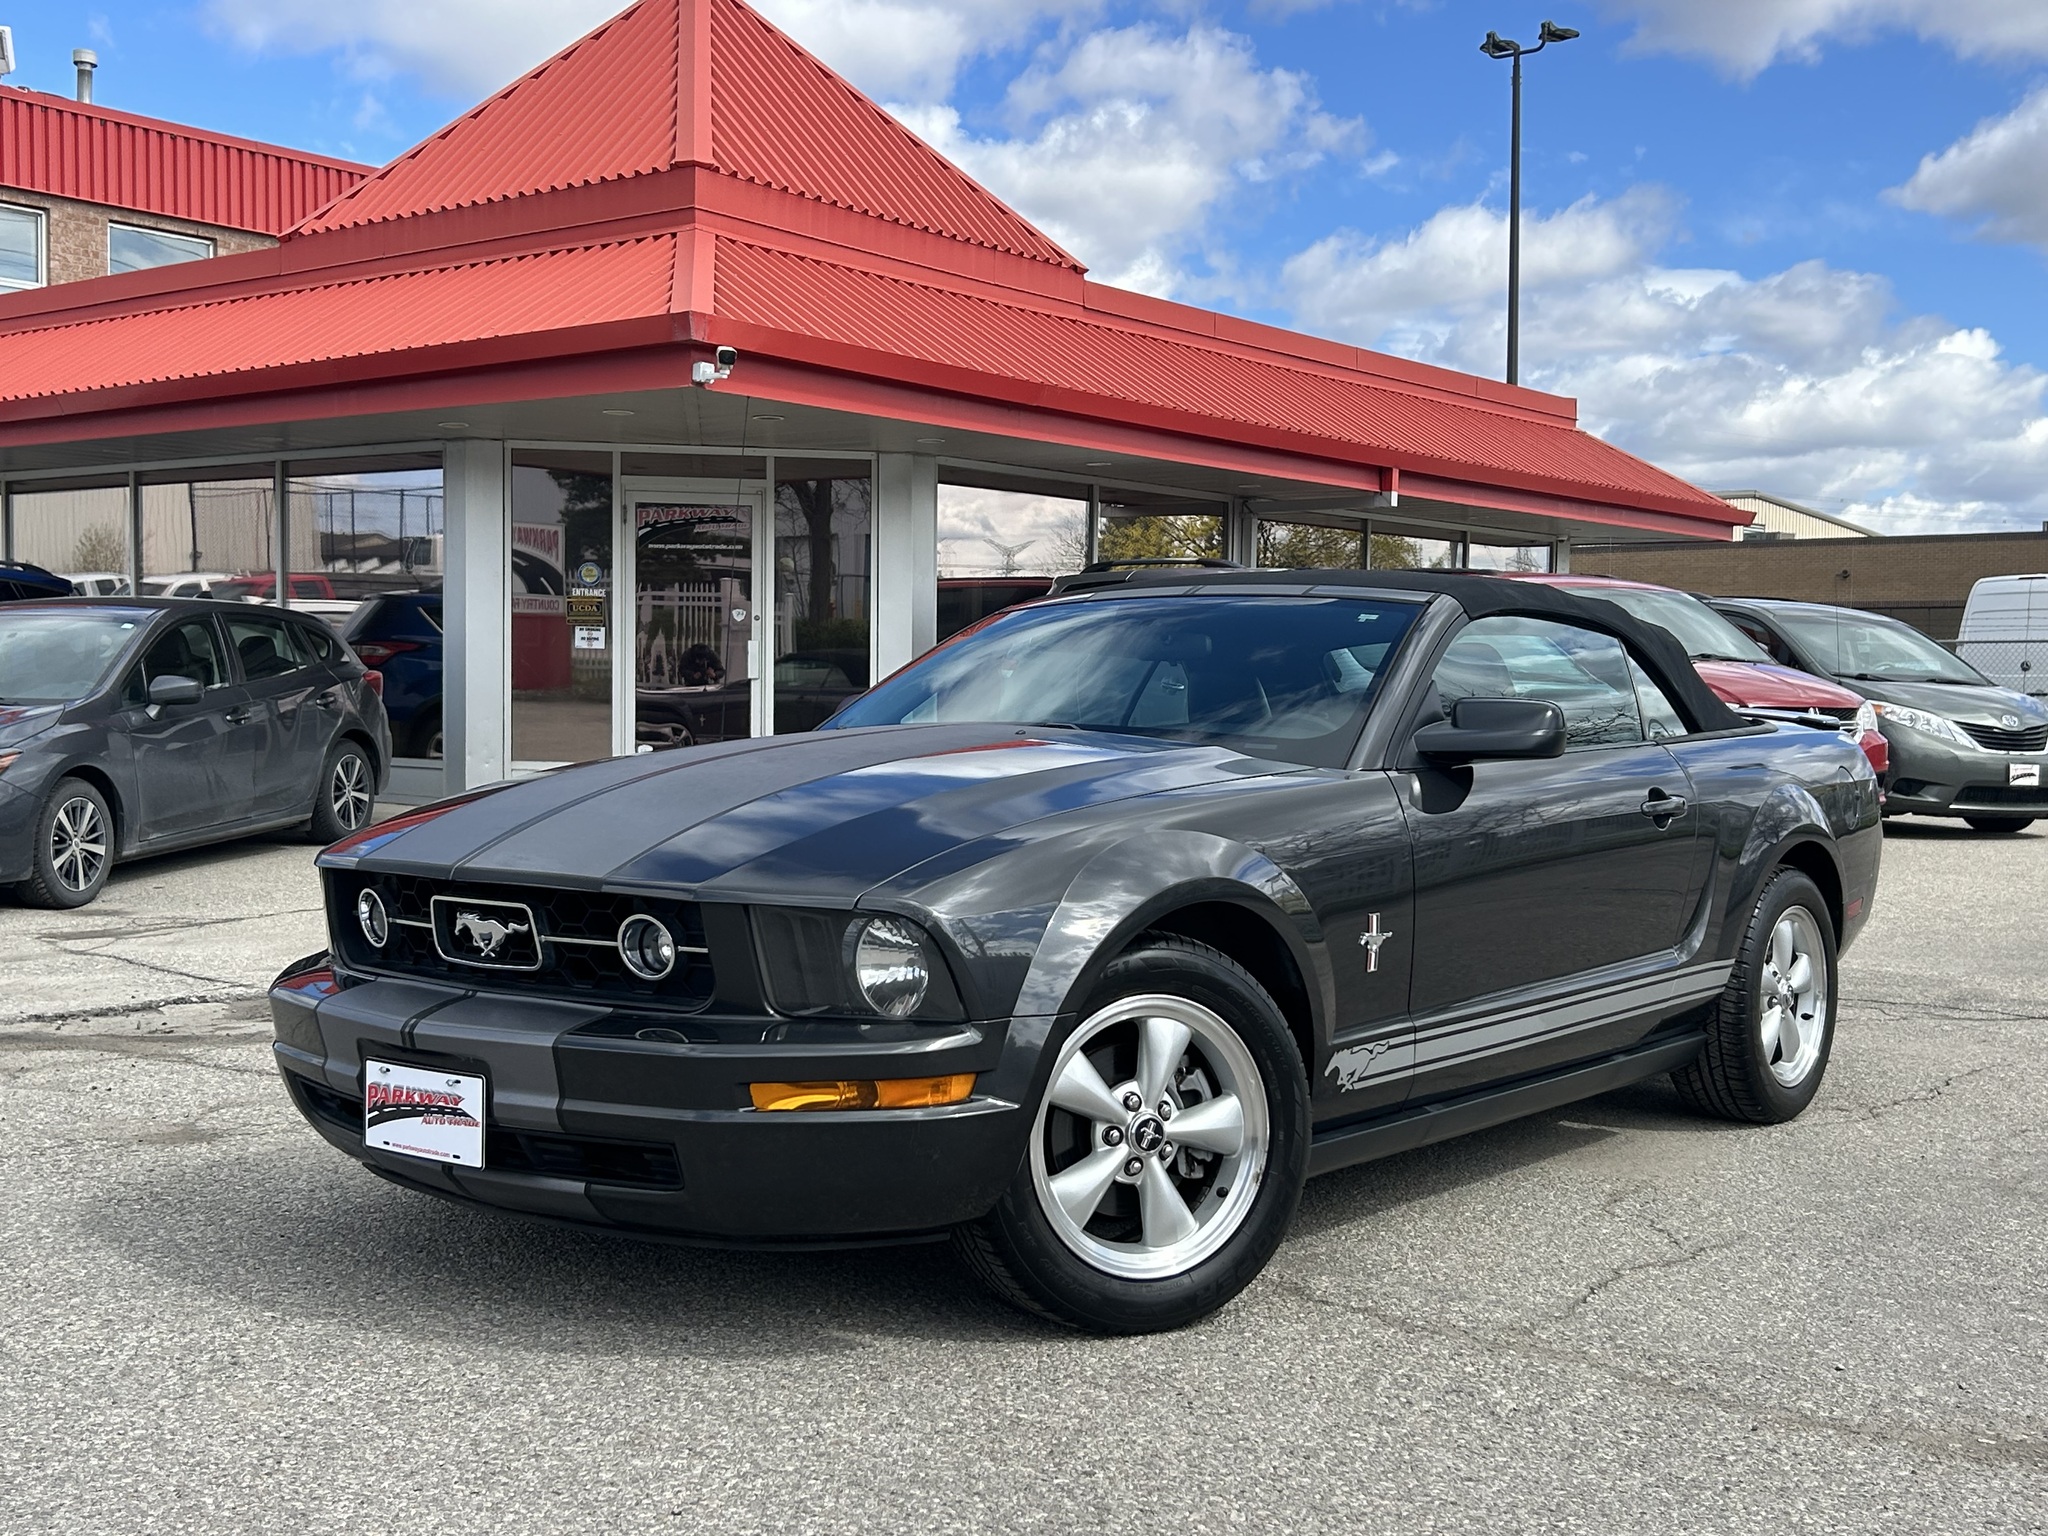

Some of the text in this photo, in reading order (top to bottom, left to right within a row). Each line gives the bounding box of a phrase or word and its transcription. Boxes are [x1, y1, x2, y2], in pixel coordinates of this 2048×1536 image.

[637, 508, 734, 528] PARKWAY
[572, 588, 606, 598] ENTRANCE
[573, 604, 598, 612] UCDA
[368, 1083, 465, 1108] PARKWAY
[421, 1114, 480, 1128] AUTO TRADE
